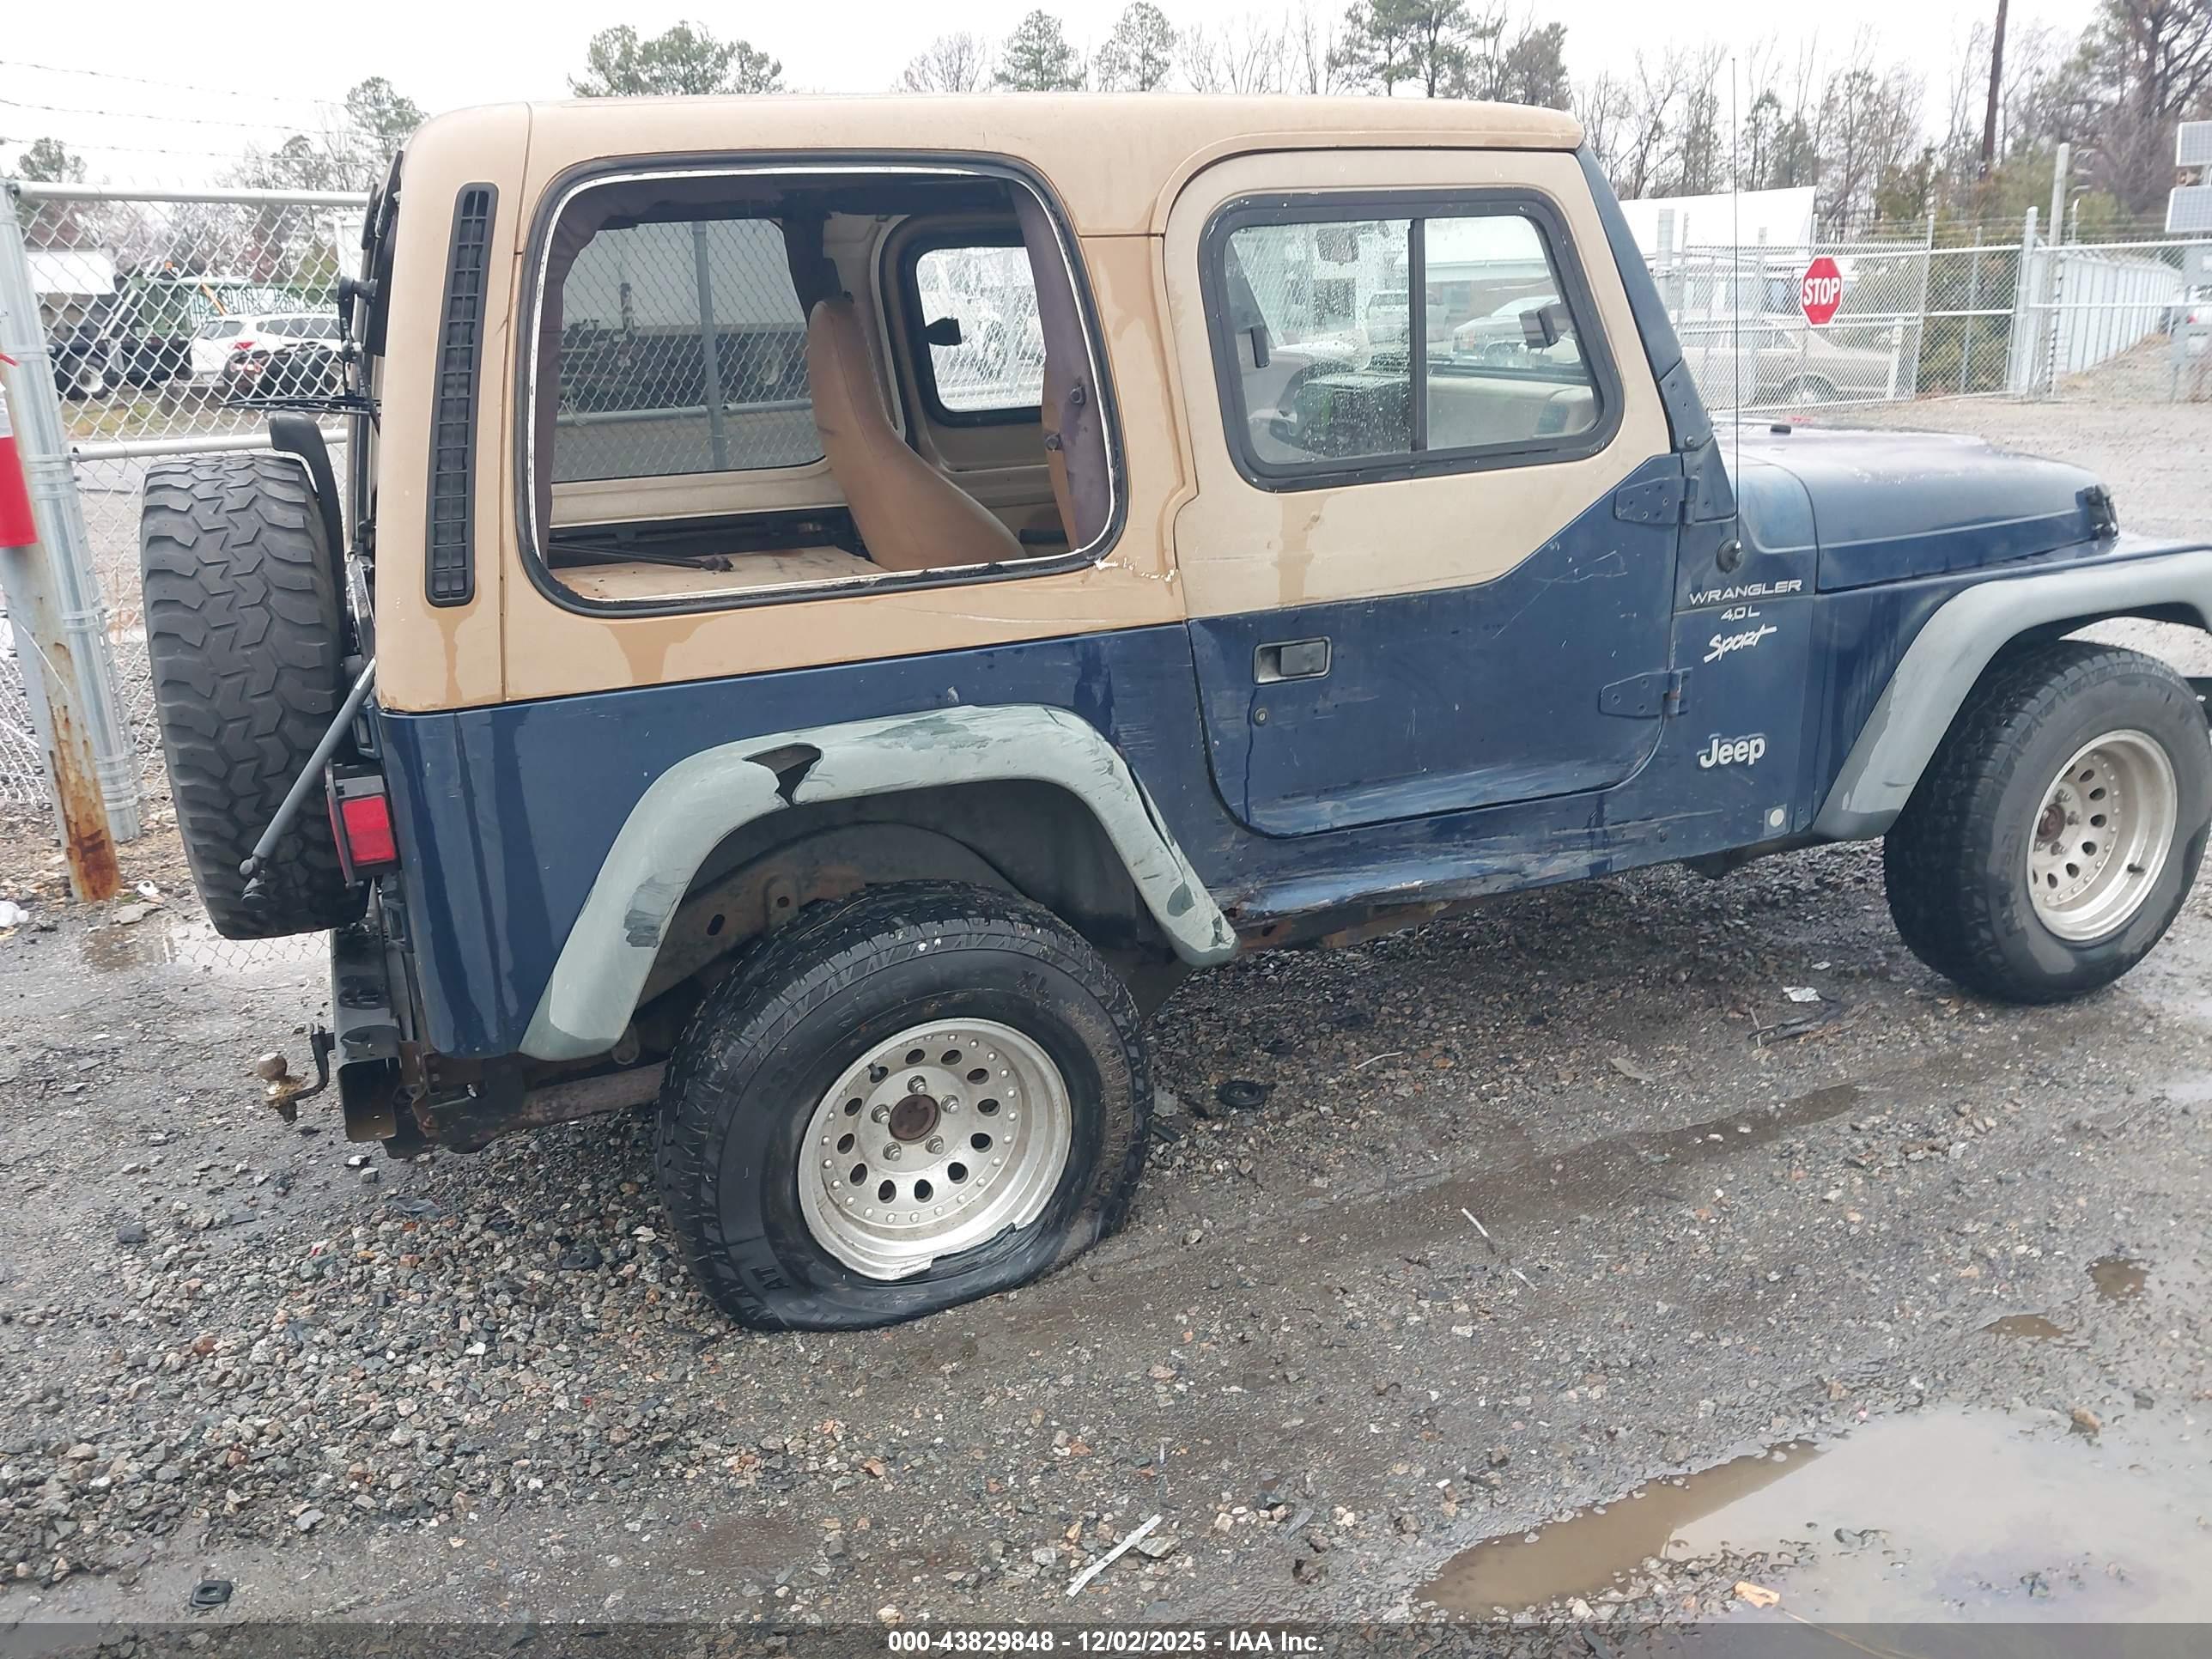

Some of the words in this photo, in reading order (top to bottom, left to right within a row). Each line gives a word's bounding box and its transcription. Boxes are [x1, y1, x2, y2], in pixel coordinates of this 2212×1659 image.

[1803, 276, 1841, 307] STOP
[1689, 579, 1802, 605] WRANGLER
[1703, 623, 1778, 663] Sport
[1698, 735, 1765, 769] Jeep
